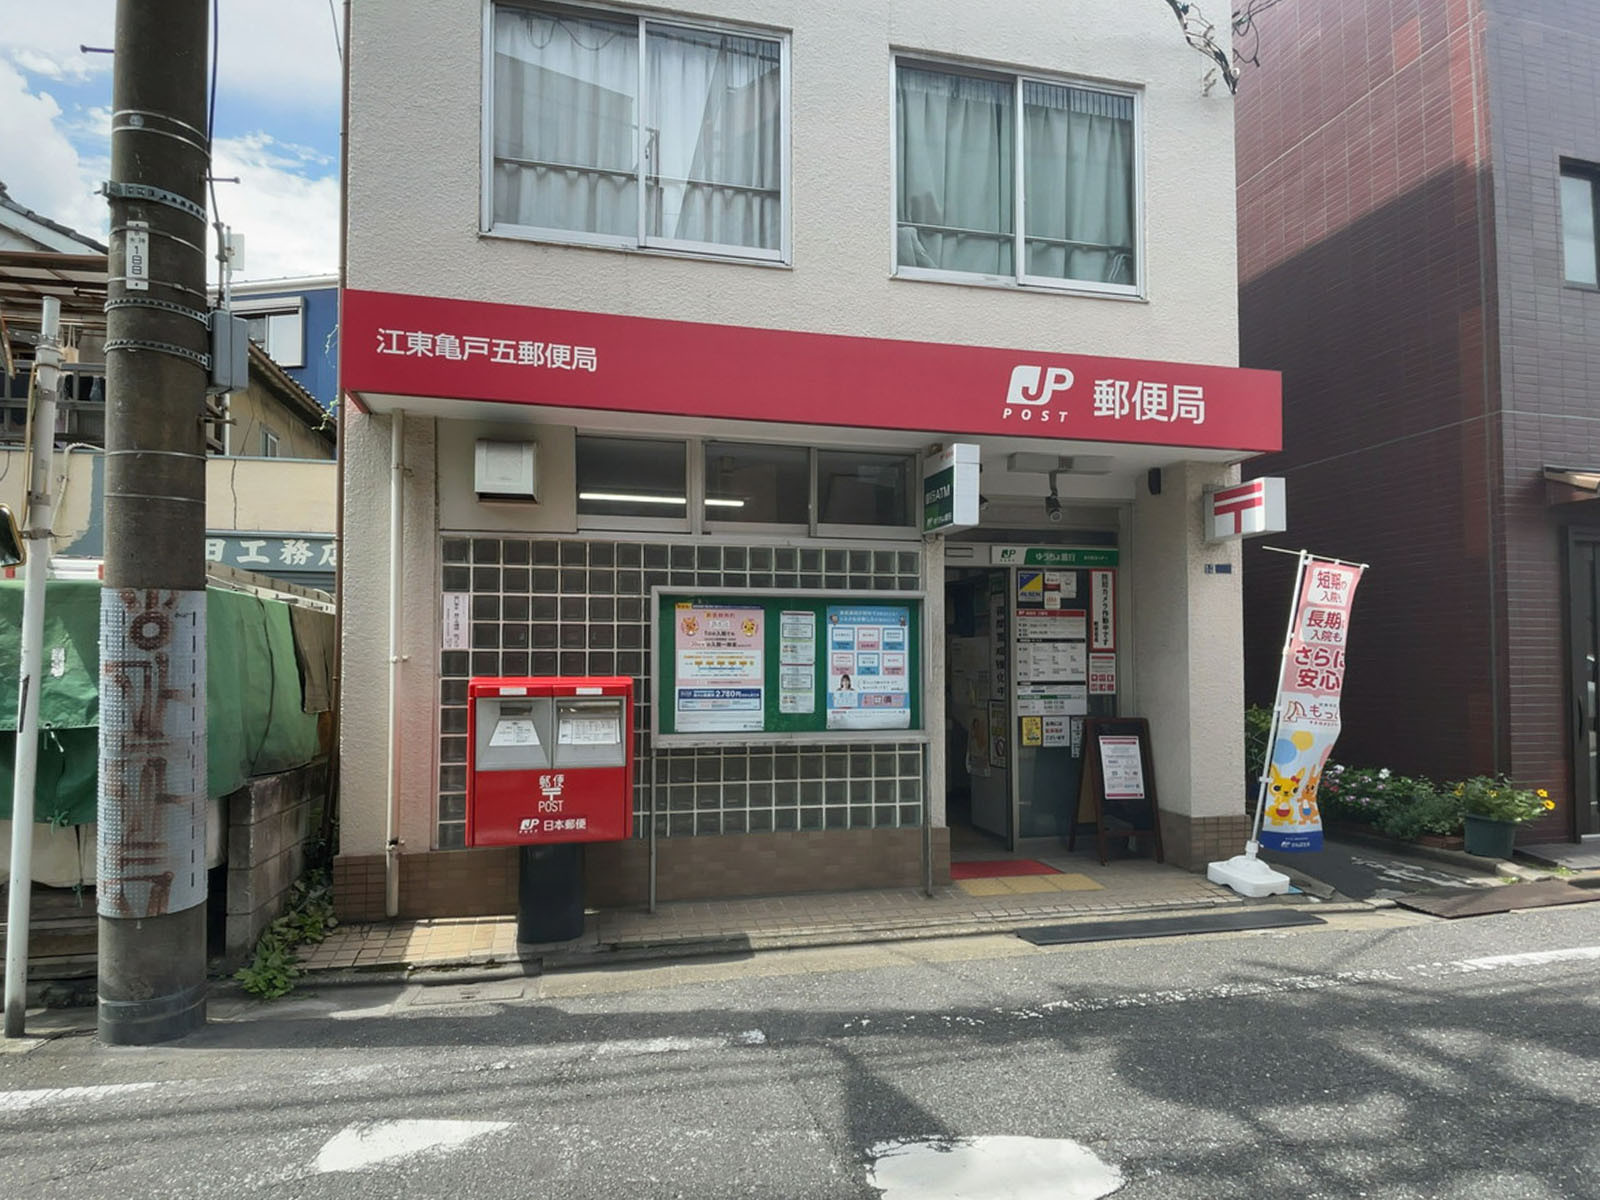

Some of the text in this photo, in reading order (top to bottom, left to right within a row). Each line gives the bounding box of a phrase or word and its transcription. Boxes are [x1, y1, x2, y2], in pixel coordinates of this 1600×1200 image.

[131, 245, 143, 276] 188
[376, 327, 598, 372] 江東亀戸五郵便局
[1006, 365, 1074, 406] JP
[1093, 379, 1205, 425] 郵便局
[1003, 408, 1069, 423] POST
[1307, 610, 1344, 629] 長期
[1311, 629, 1342, 642] 入院も
[1295, 647, 1345, 668] さらに
[1297, 667, 1340, 690] 安心
[539, 774, 564, 788] 郵便
[538, 801, 564, 813] POST
[543, 818, 586, 831] 日本郵便
